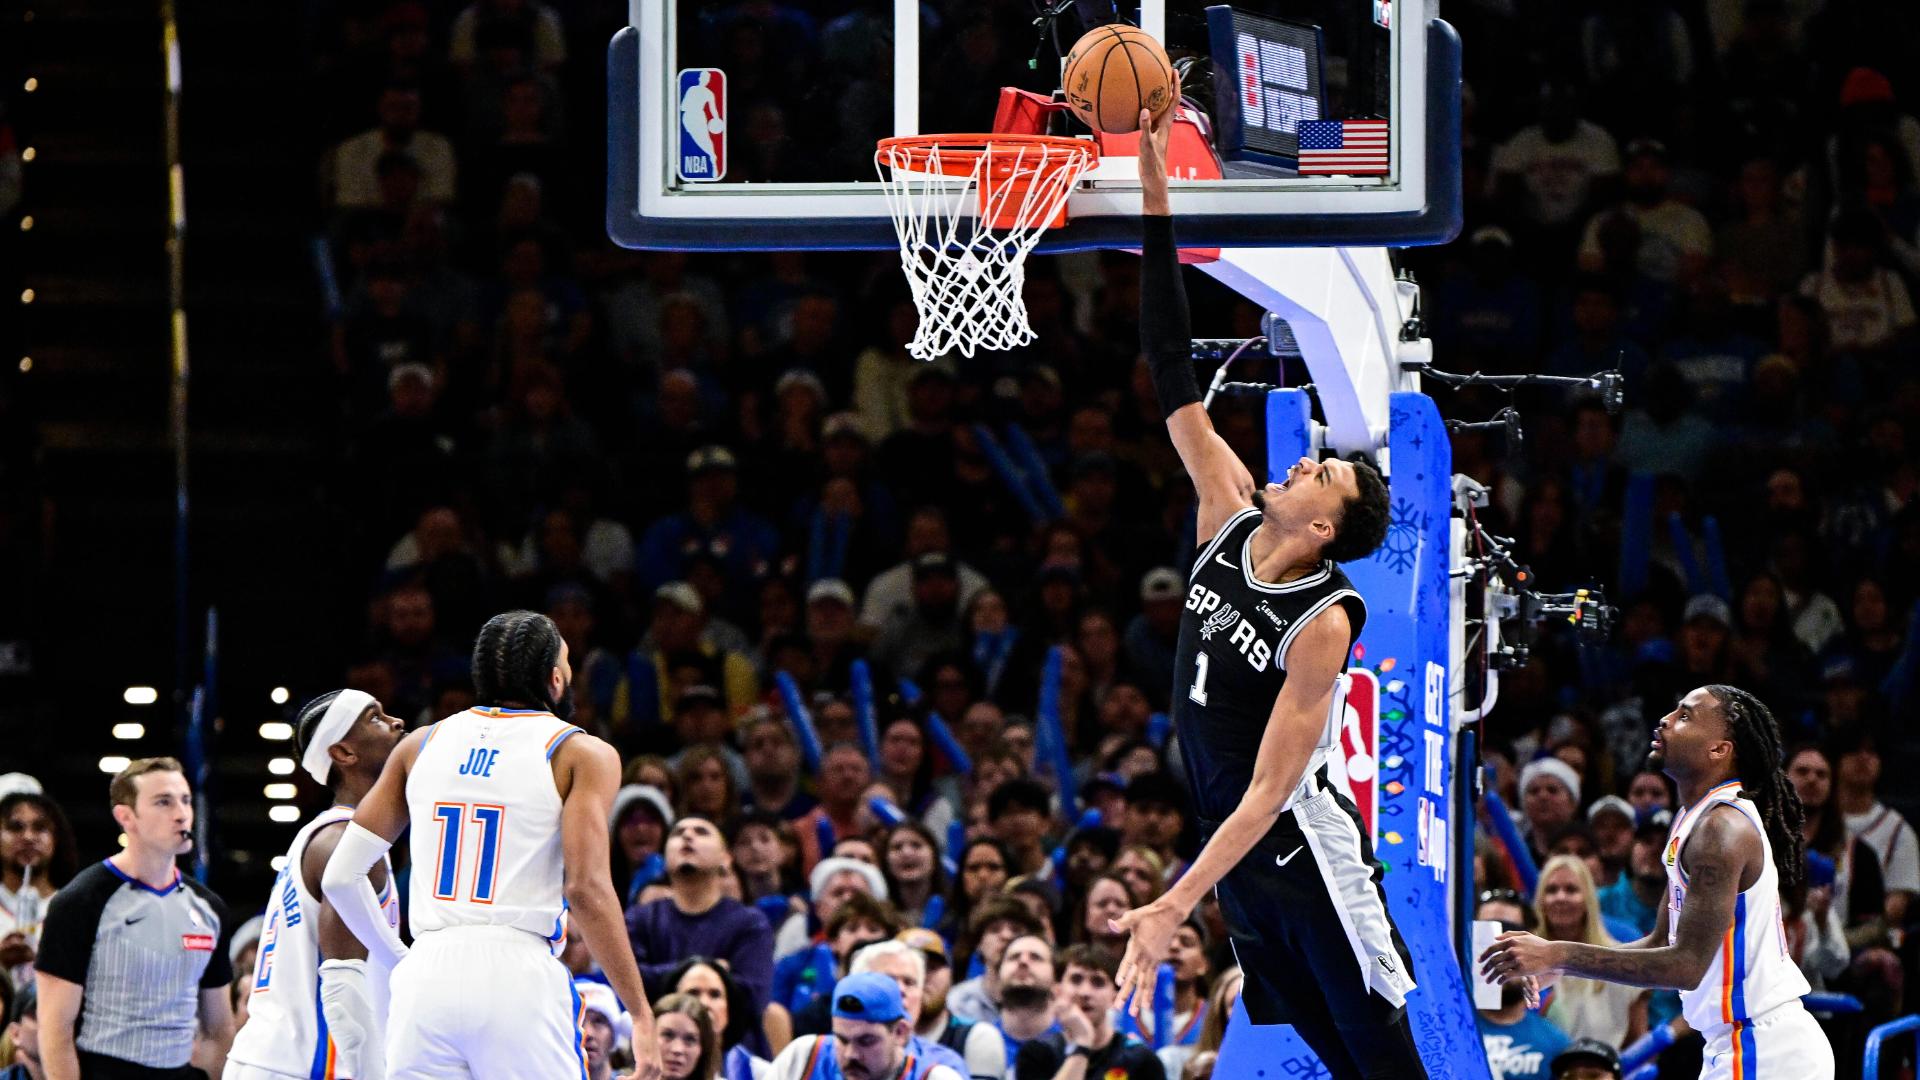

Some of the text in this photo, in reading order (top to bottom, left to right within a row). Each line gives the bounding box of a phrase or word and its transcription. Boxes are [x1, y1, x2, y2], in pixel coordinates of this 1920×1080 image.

[684, 155, 708, 174] NBA
[1186, 584, 1271, 672] SPURS
[1189, 651, 1209, 707] 1
[1425, 661, 1445, 727] GET
[459, 748, 500, 777] JOE
[1424, 729, 1444, 797] THE
[433, 801, 505, 904] 11
[254, 908, 281, 993] 2
